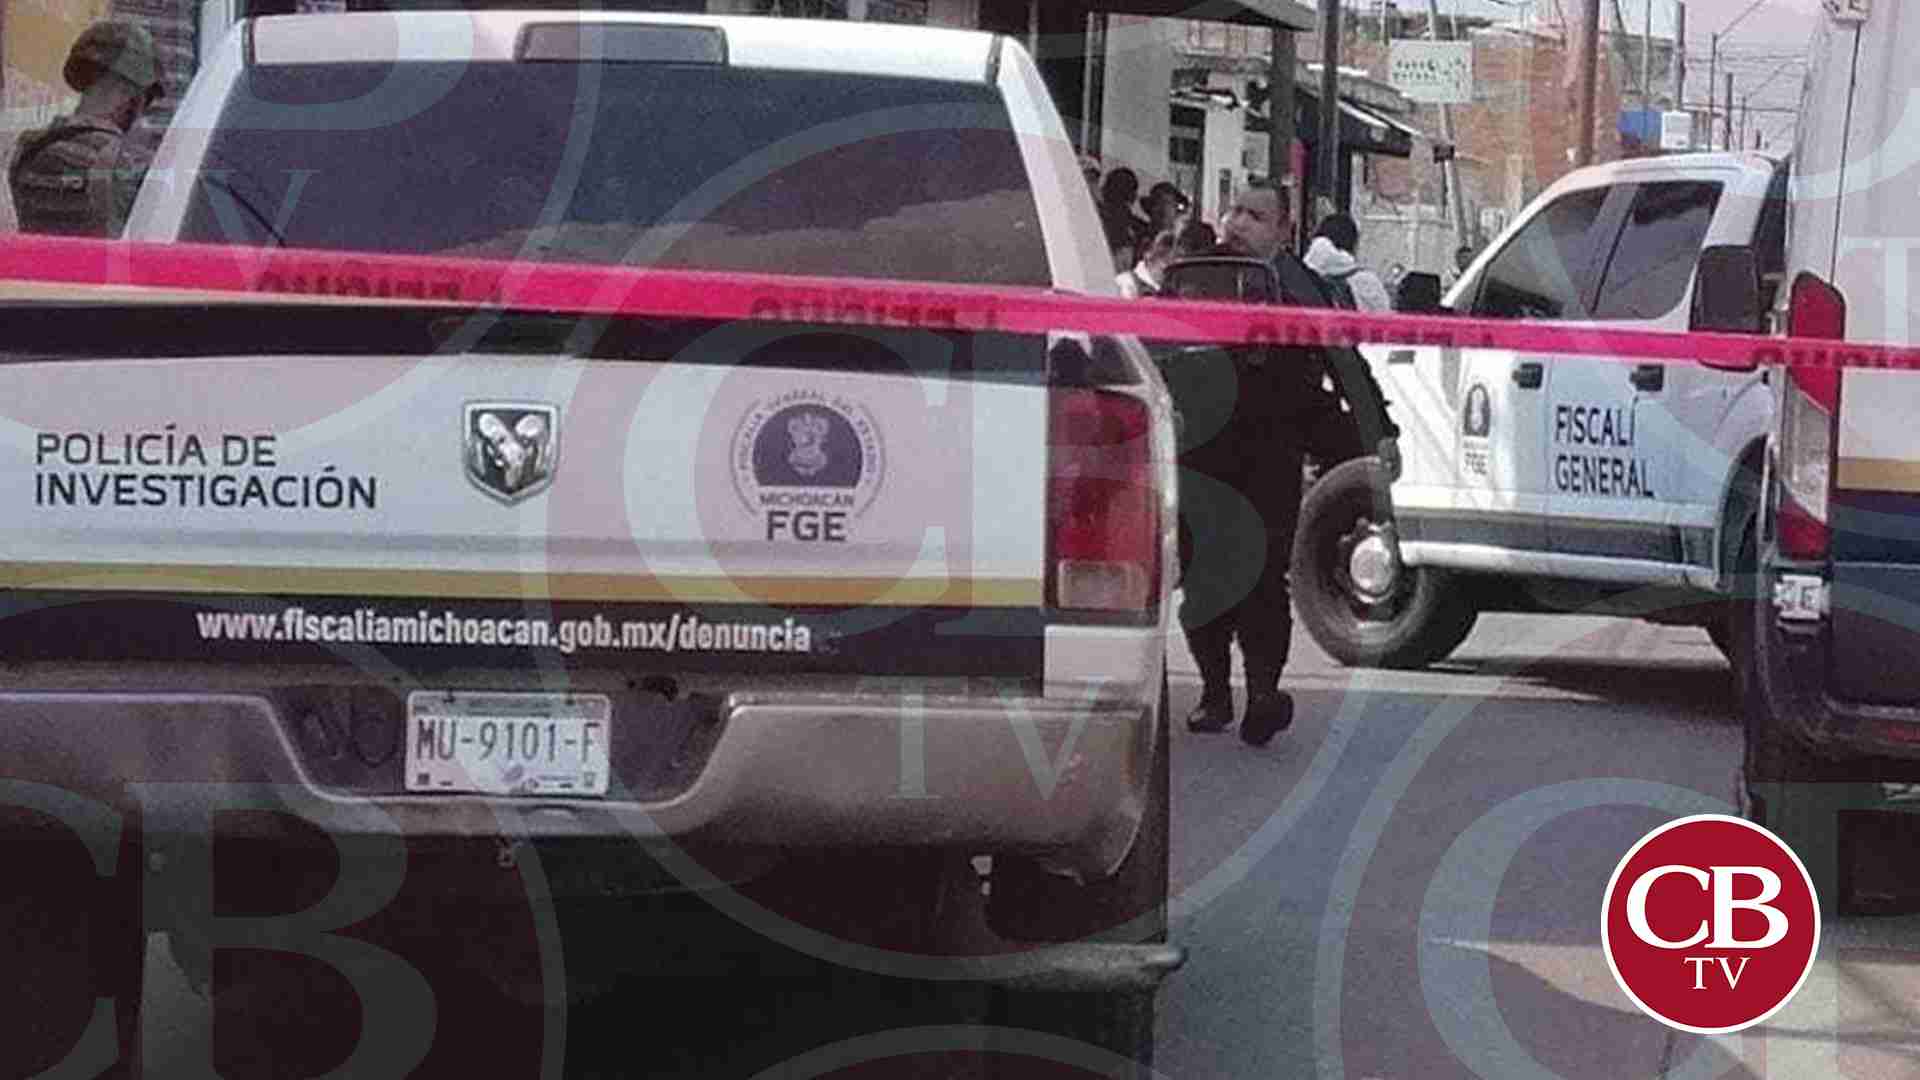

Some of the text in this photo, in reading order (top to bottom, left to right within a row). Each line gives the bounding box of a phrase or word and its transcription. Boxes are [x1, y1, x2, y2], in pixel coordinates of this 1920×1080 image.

[36, 423, 277, 467] POLICÍA DE
[35, 466, 377, 509] INVESTIGACIÓN
[1555, 454, 1655, 499] GENERAL
[767, 510, 846, 541] FGE
[196, 606, 811, 653] www.fiscaliamichoacan.gob.mx/denuncia
[416, 718, 601, 763] MU-9101-F
